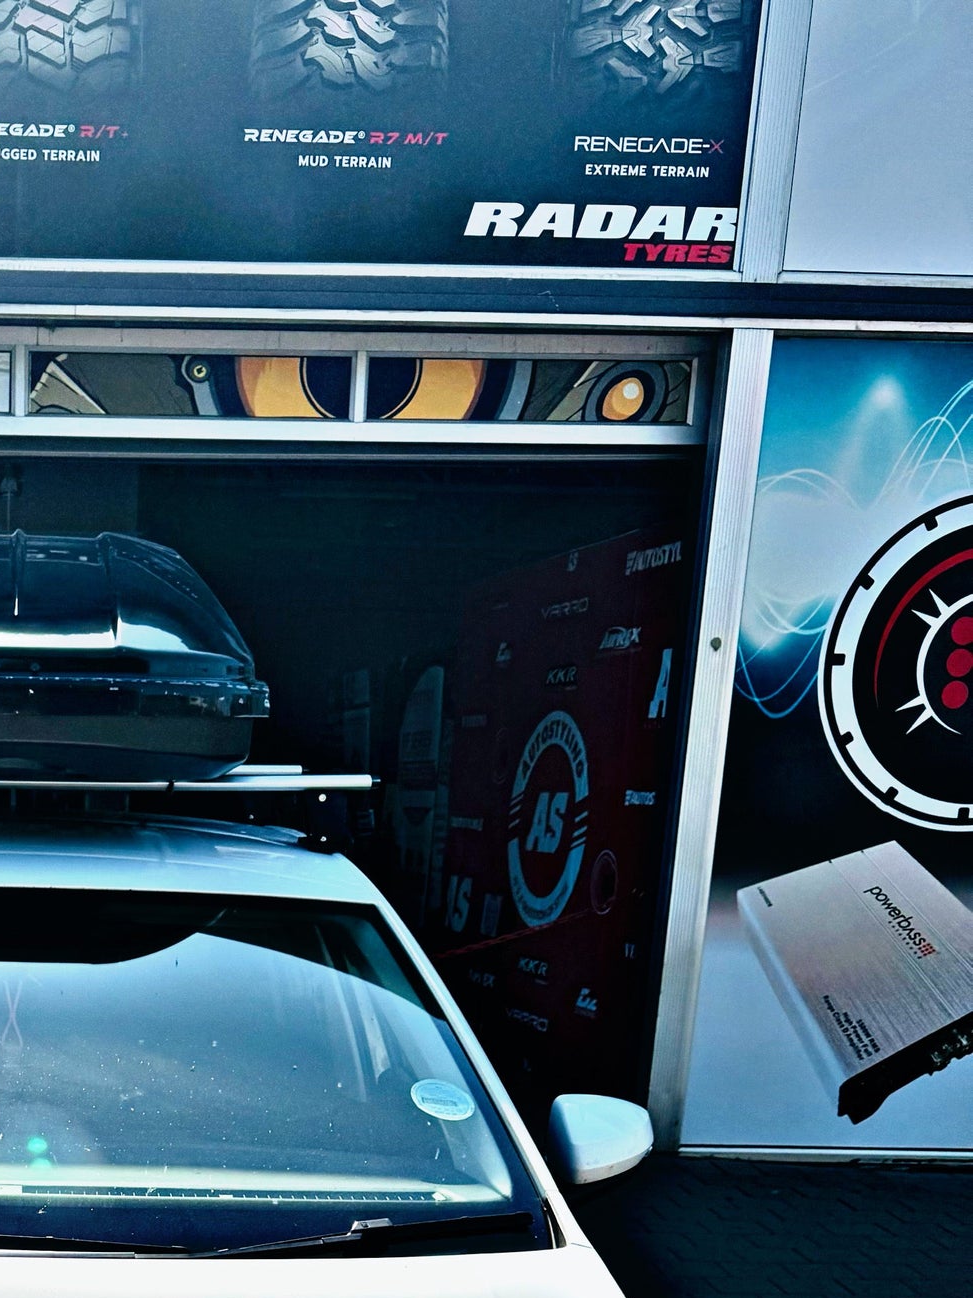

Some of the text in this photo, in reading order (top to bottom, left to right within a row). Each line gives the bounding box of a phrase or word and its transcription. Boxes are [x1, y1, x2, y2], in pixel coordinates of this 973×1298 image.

[369, 132, 400, 145] R7
[403, 131, 449, 146] M/T
[574, 135, 725, 155] RENEGADE-X
[42, 149, 100, 162] TERRAIN
[298, 155, 392, 169] MUD TERRAIN
[585, 164, 710, 178] EXTREME TERRAIN
[463, 201, 739, 242] RADAR
[624, 243, 733, 263] TYRES
[527, 792, 569, 854] AS
